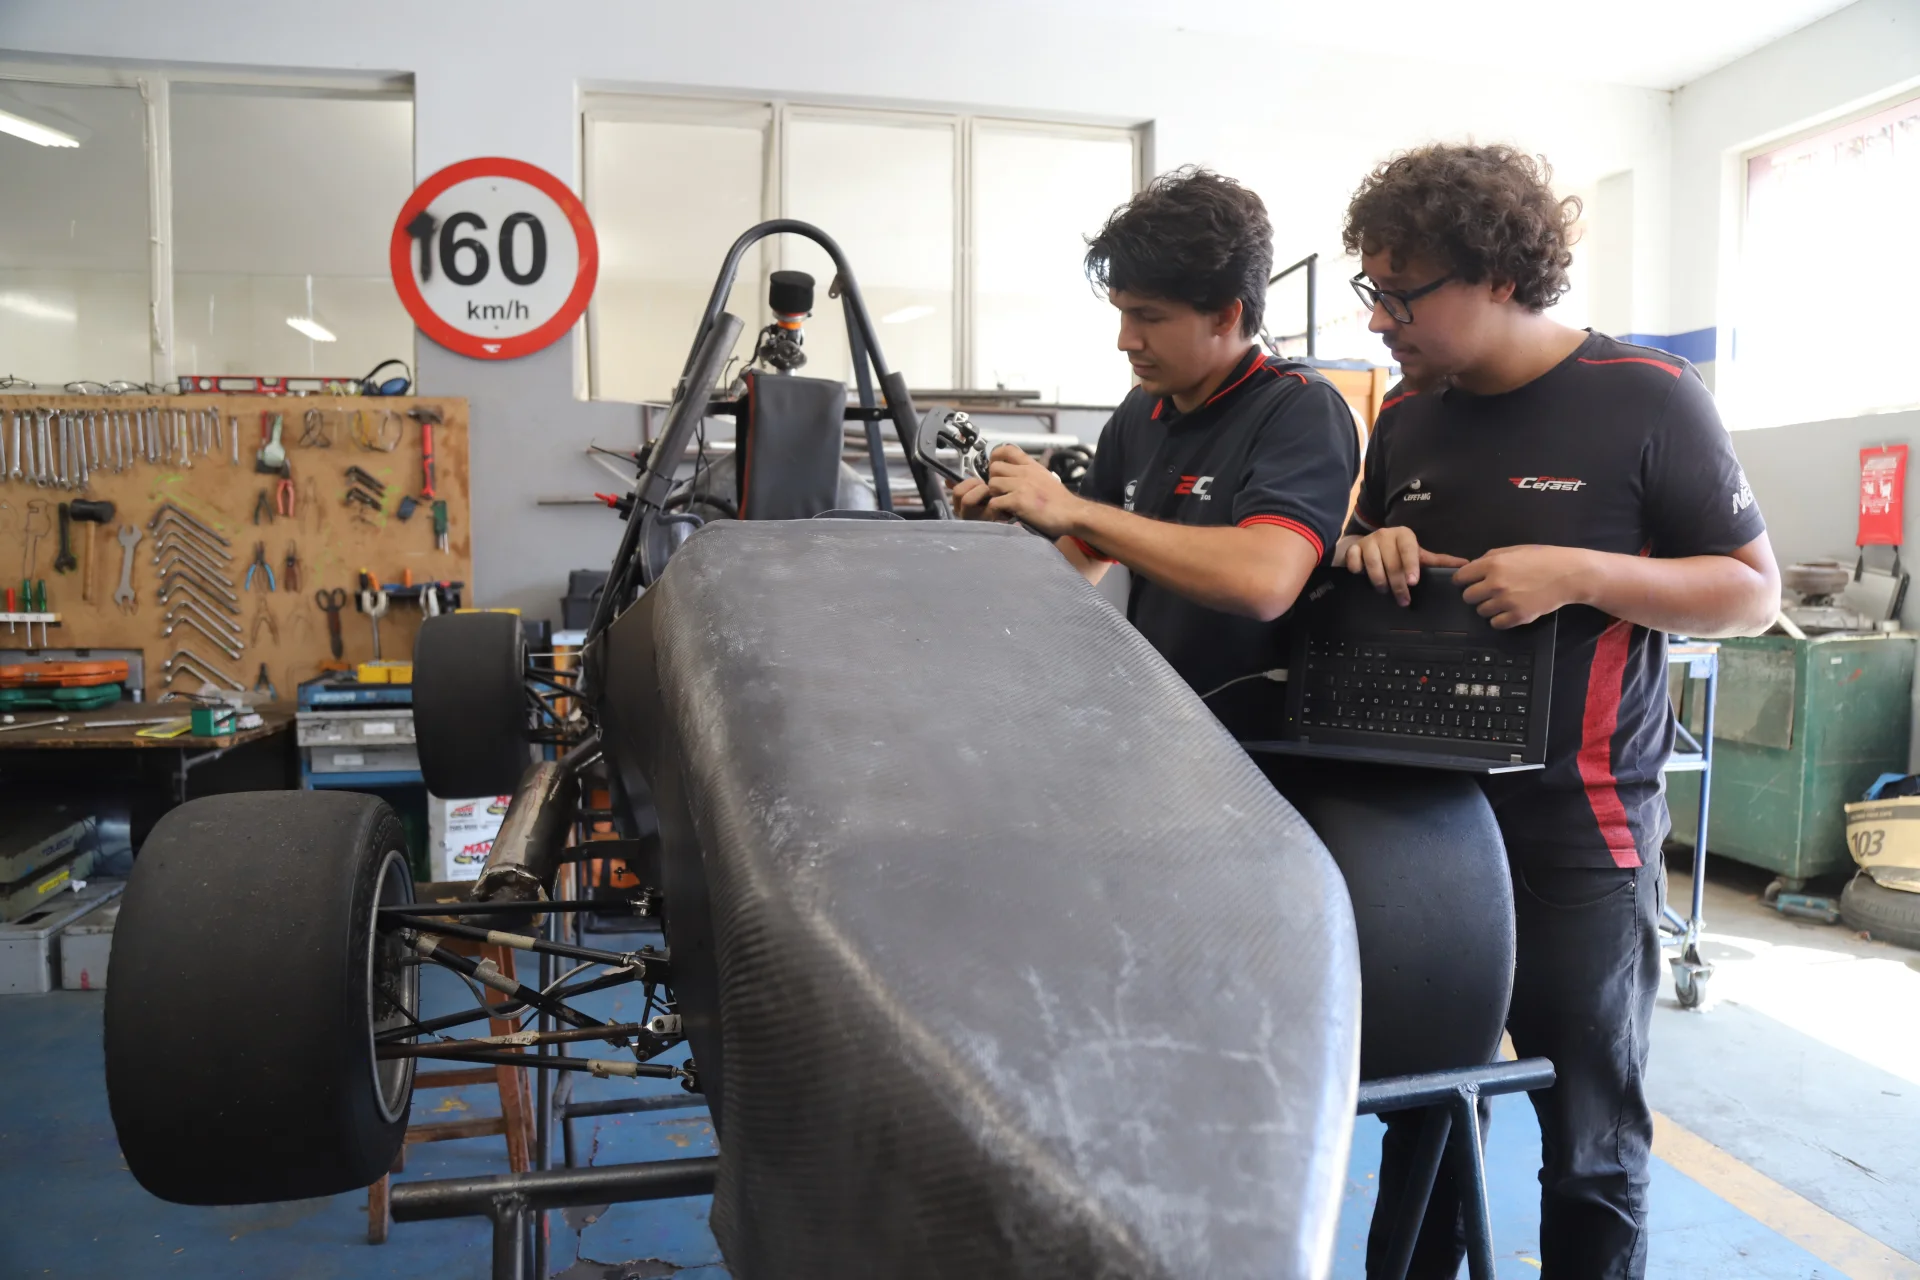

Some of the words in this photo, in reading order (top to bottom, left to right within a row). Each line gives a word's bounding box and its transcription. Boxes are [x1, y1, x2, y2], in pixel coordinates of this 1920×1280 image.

[467, 300, 529, 320] km/h
[1518, 477, 1587, 491] Cefast
[1852, 829, 1885, 857] 103
